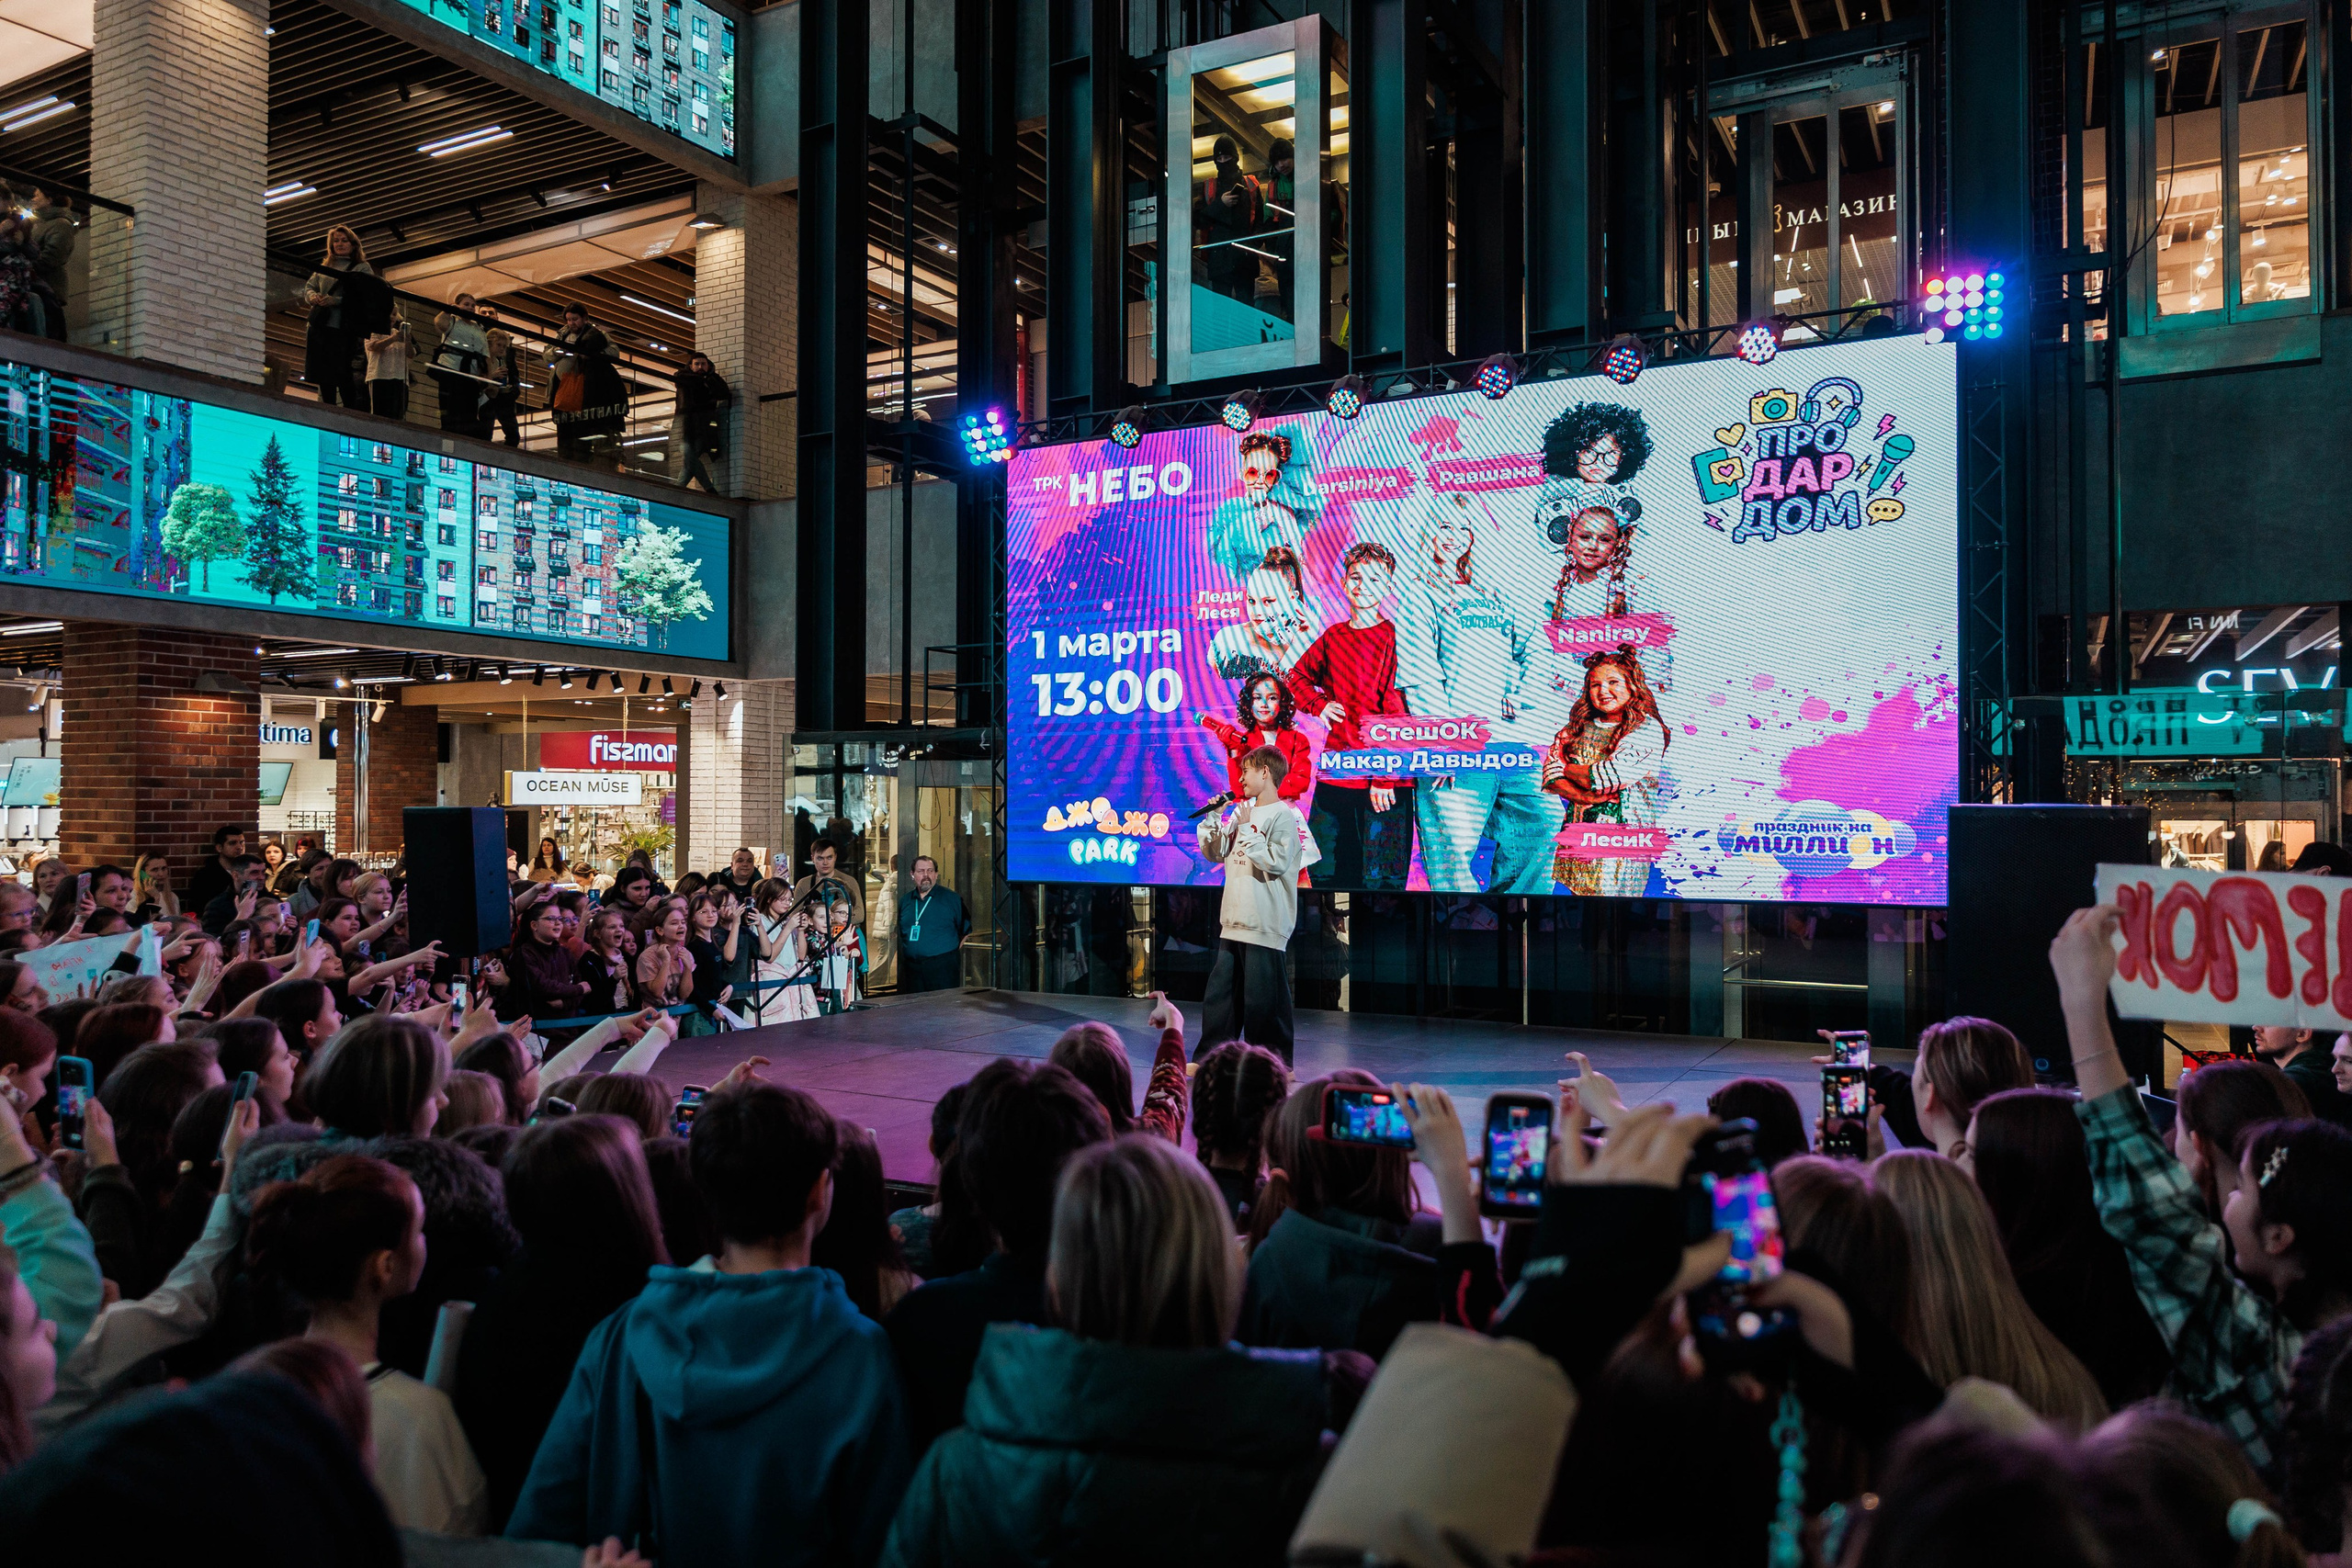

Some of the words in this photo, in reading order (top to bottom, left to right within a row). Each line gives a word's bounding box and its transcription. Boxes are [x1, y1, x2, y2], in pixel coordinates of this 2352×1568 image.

[1786, 194, 1896, 228] МААЗИН
[1757, 421, 1848, 458] ПРО
[1033, 475, 1063, 491] ТРК
[1069, 461, 1193, 506] НЕБО
[1439, 464, 1541, 487] Равшана
[1742, 452, 1855, 502] ДАР
[1733, 491, 1861, 544] ДОМ
[1196, 591, 1244, 604] Леди
[1196, 607, 1240, 620] Леся
[1031, 630, 1046, 660] 1
[1058, 628, 1182, 663] марта
[1558, 624, 1651, 644] Naniray
[1031, 667, 1183, 716] 13:00
[258, 721, 313, 743] tima
[1320, 752, 1403, 773] Макар
[1408, 750, 1534, 772] Давыдов
[526, 779, 582, 792] OCEAN
[1753, 821, 1844, 834] праздник
[1849, 821, 1872, 833] на
[1069, 836, 1140, 867] PARK
